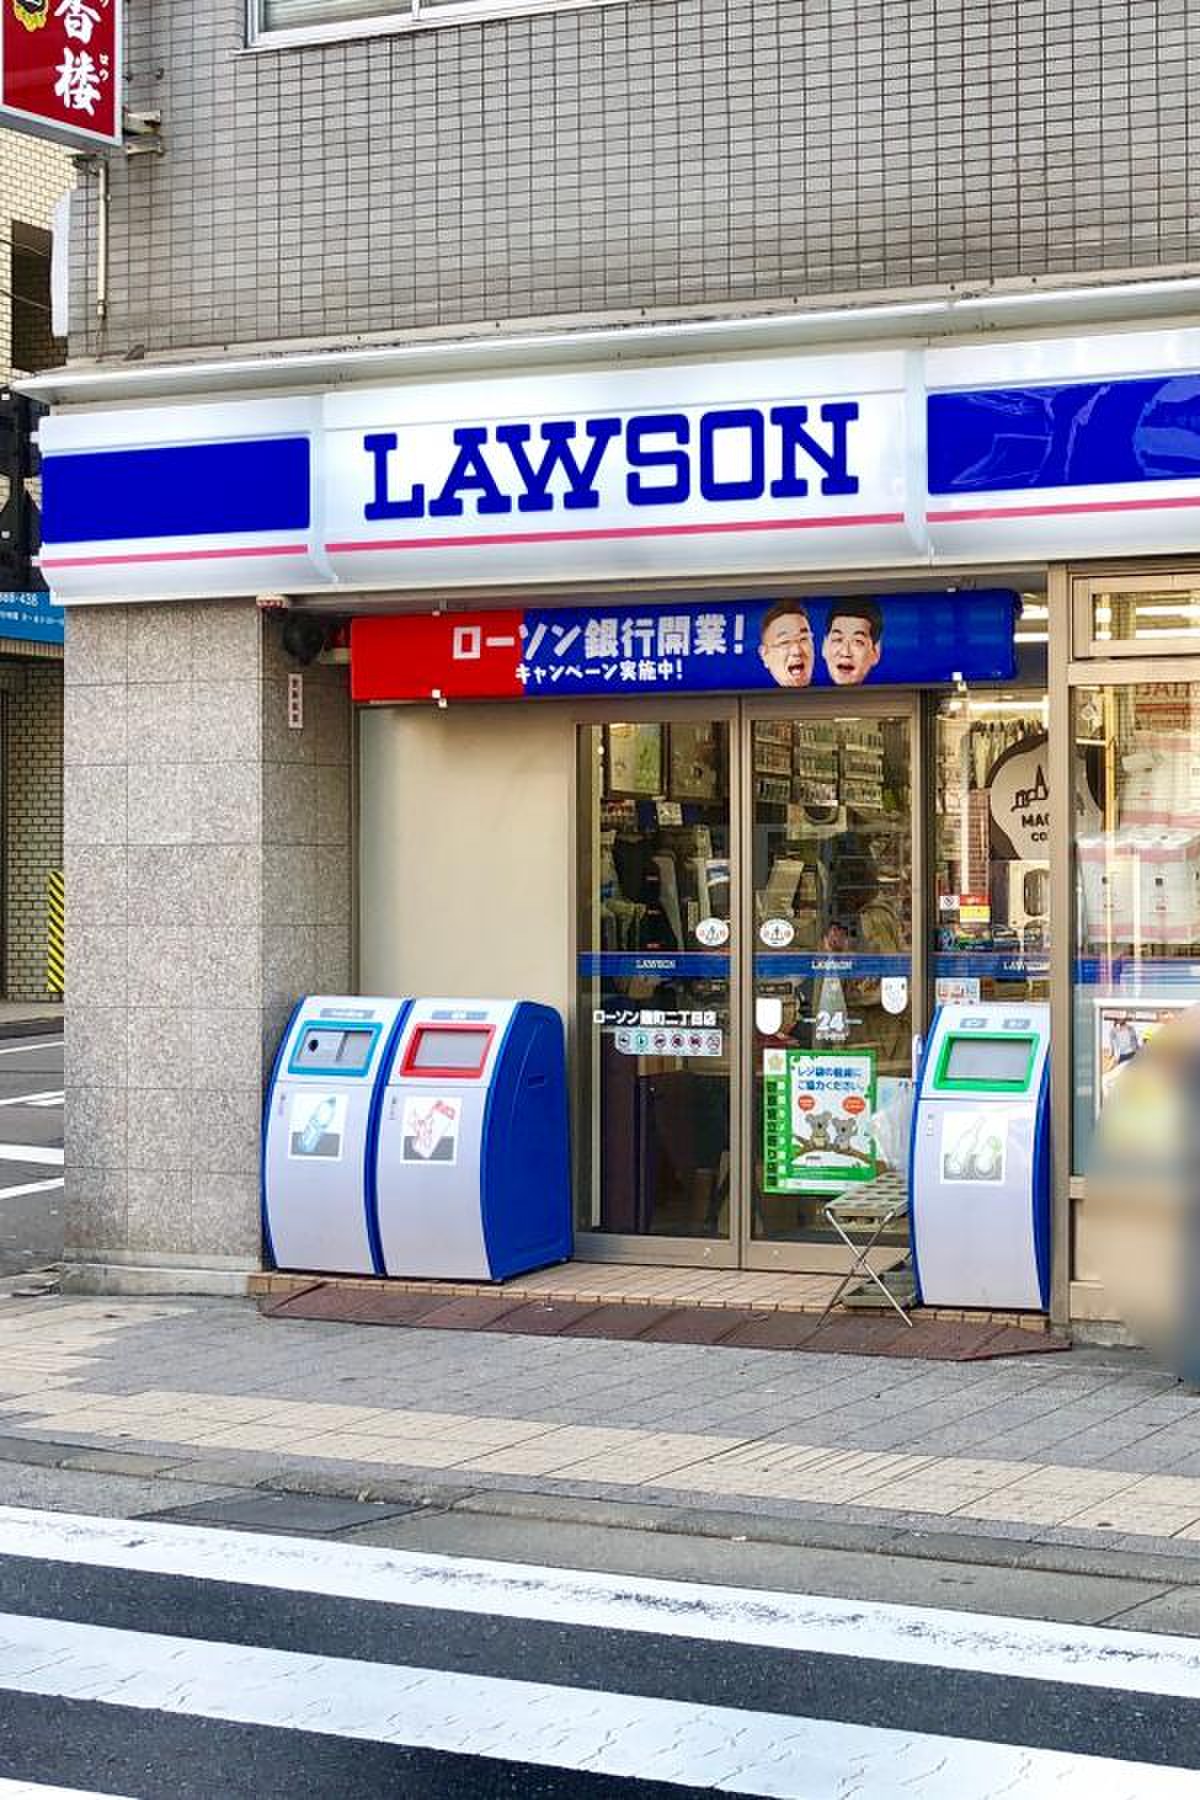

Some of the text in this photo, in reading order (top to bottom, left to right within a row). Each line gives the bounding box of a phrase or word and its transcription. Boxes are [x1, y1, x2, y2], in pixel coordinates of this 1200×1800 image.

[363, 401, 860, 521] LAWSON
[452, 612, 745, 661] ローソン銀行開業!
[514, 659, 684, 684] キャンペーン実施中!
